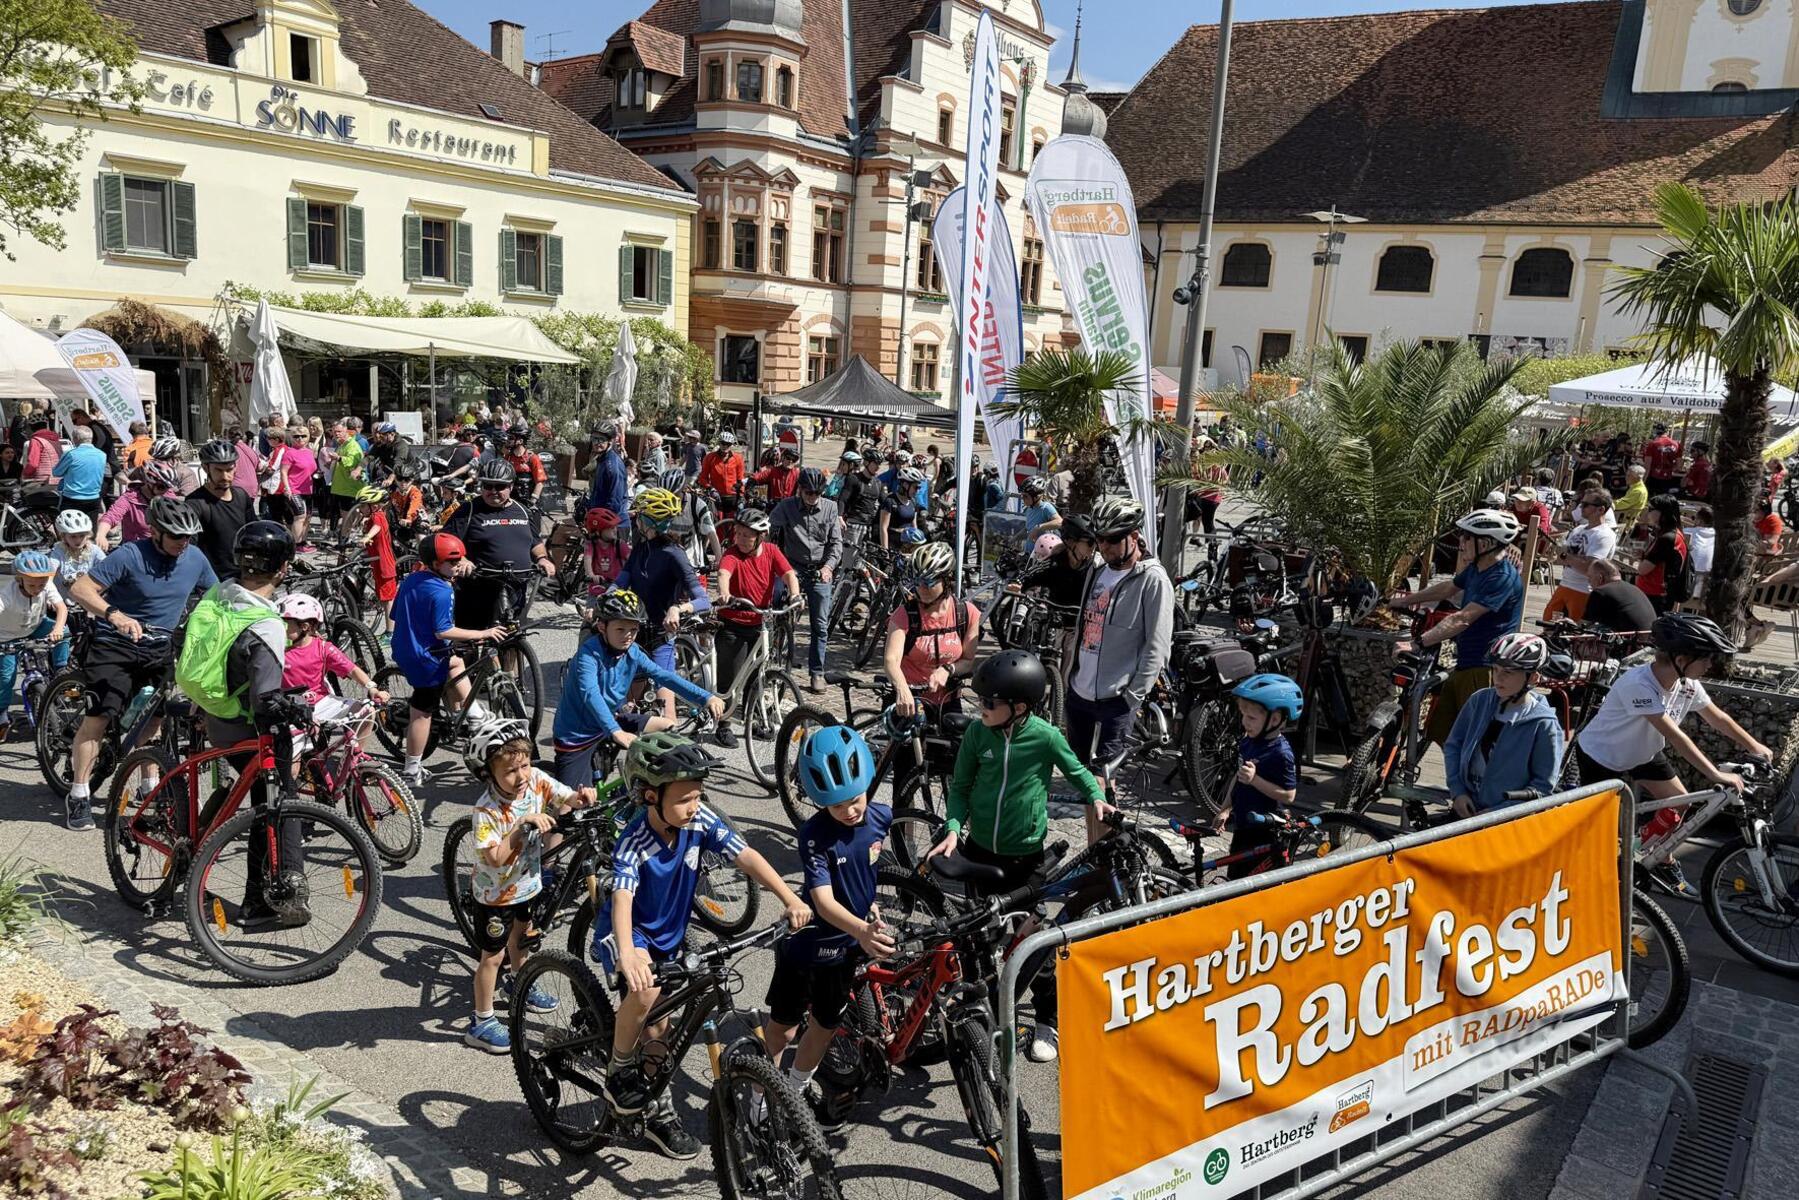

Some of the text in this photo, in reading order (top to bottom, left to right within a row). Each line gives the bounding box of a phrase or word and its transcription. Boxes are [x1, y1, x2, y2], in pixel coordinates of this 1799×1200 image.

[148, 69, 215, 109] Café
[271, 84, 298, 103] Die
[256, 99, 357, 142] SONNE
[388, 117, 517, 164] Restaurant
[967, 45, 996, 353] INTERSPORT
[1585, 391, 1723, 408] Prosecco aus Valdobbi
[1103, 877, 1415, 1032] Hartberger
[1204, 869, 1570, 1110] Radfest
[1412, 967, 1605, 1071] mit RADpaRADe
[1338, 1091, 1370, 1110] Hartberg
[1240, 1121, 1314, 1164] Hartberg
[1133, 1171, 1192, 1200] Klimaregion
[1206, 1155, 1227, 1176] GO
